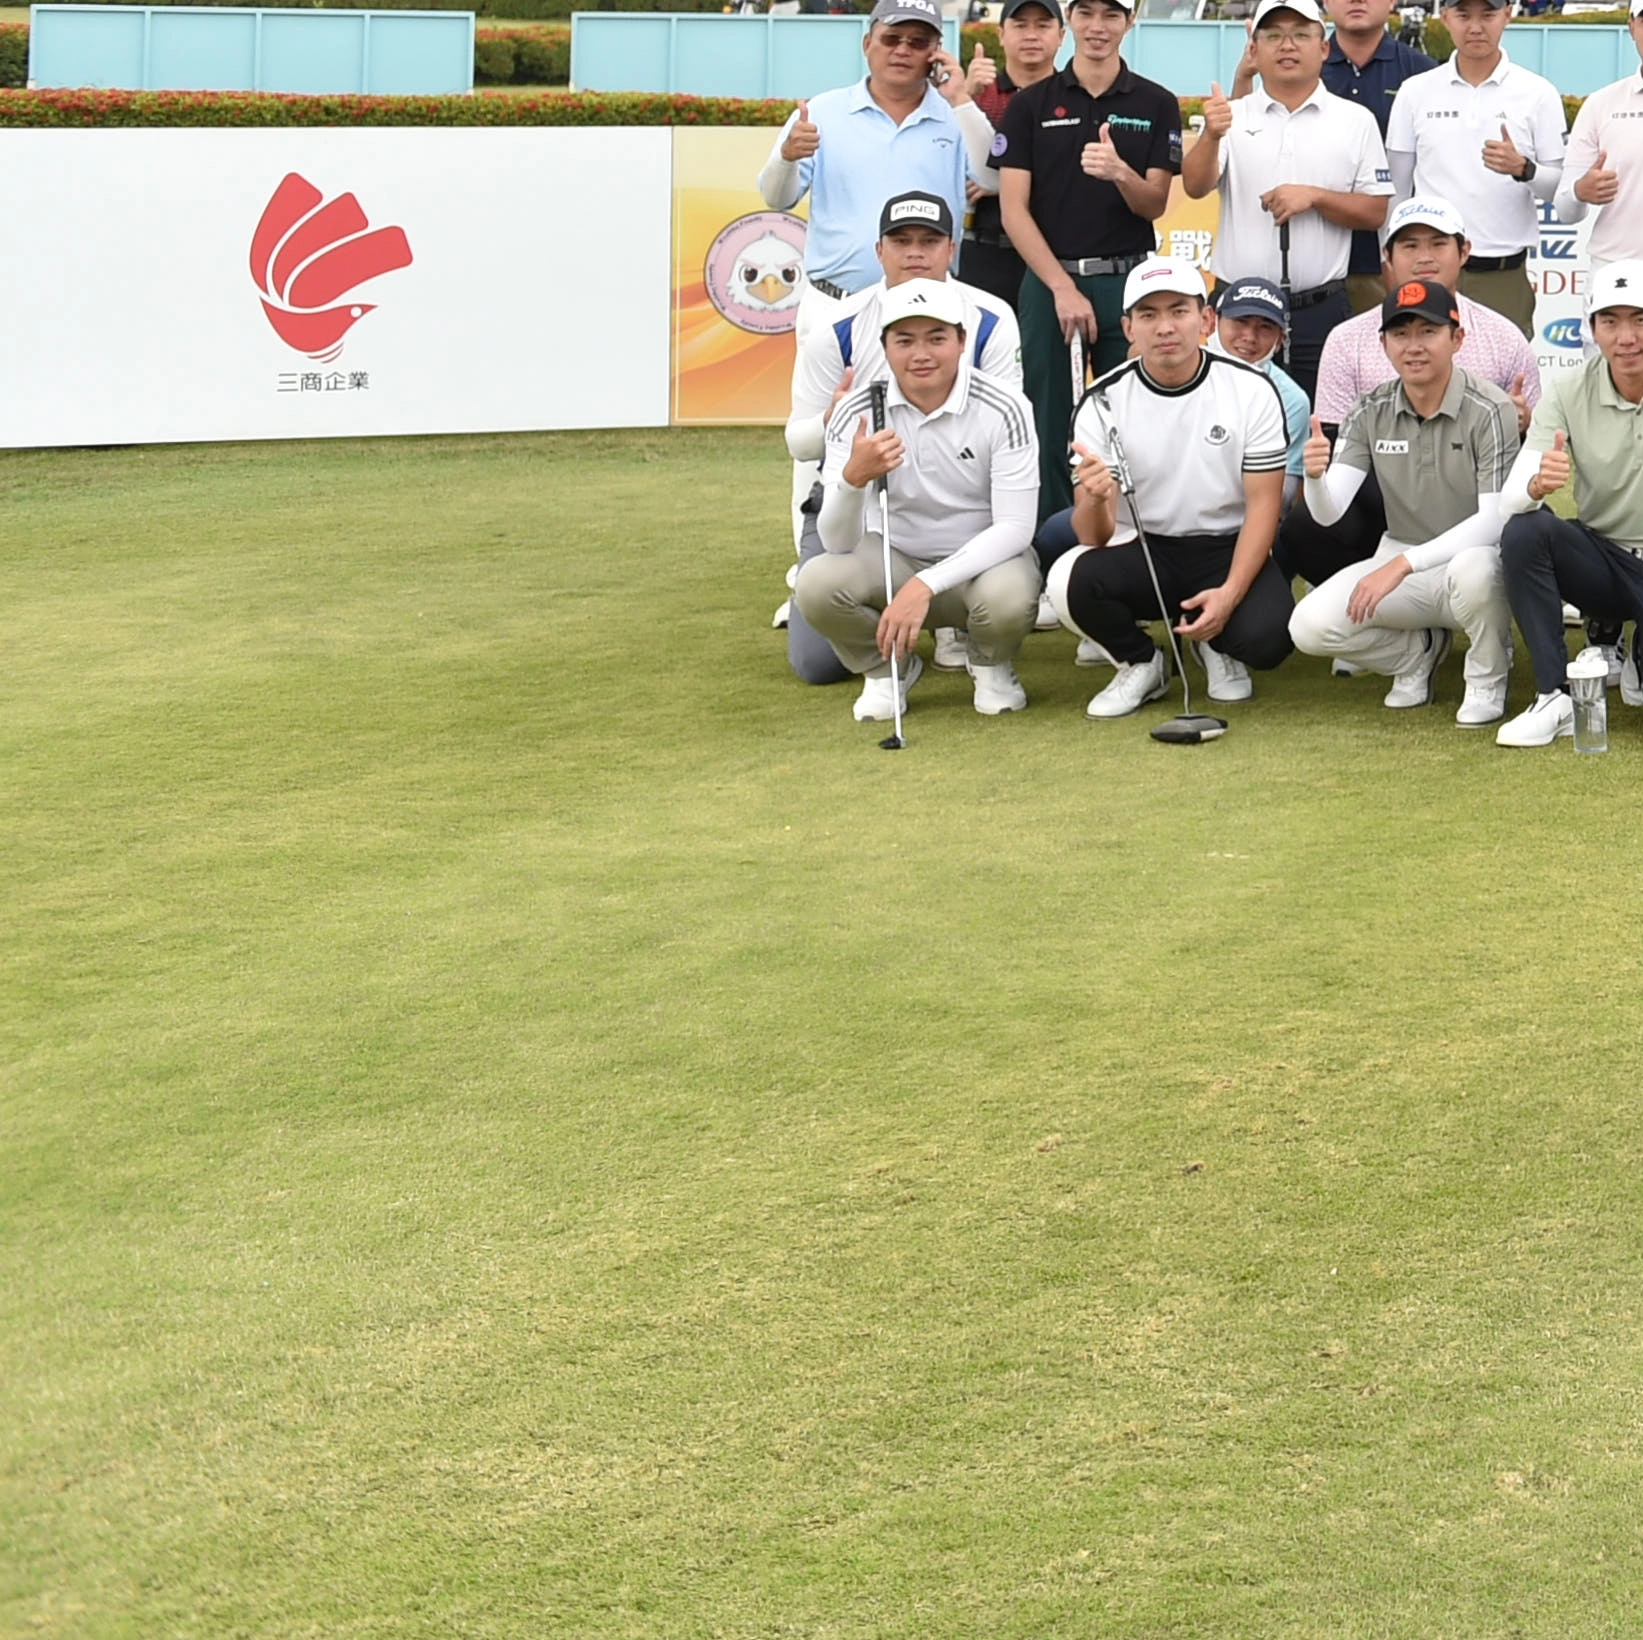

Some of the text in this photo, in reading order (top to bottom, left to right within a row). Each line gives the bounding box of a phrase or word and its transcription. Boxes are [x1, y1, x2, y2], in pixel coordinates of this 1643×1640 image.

[895, 204, 937, 216] PING
[1395, 204, 1446, 224] Titleist
[1232, 285, 1284, 310] Titleist
[275, 370, 371, 393] 三商企業
